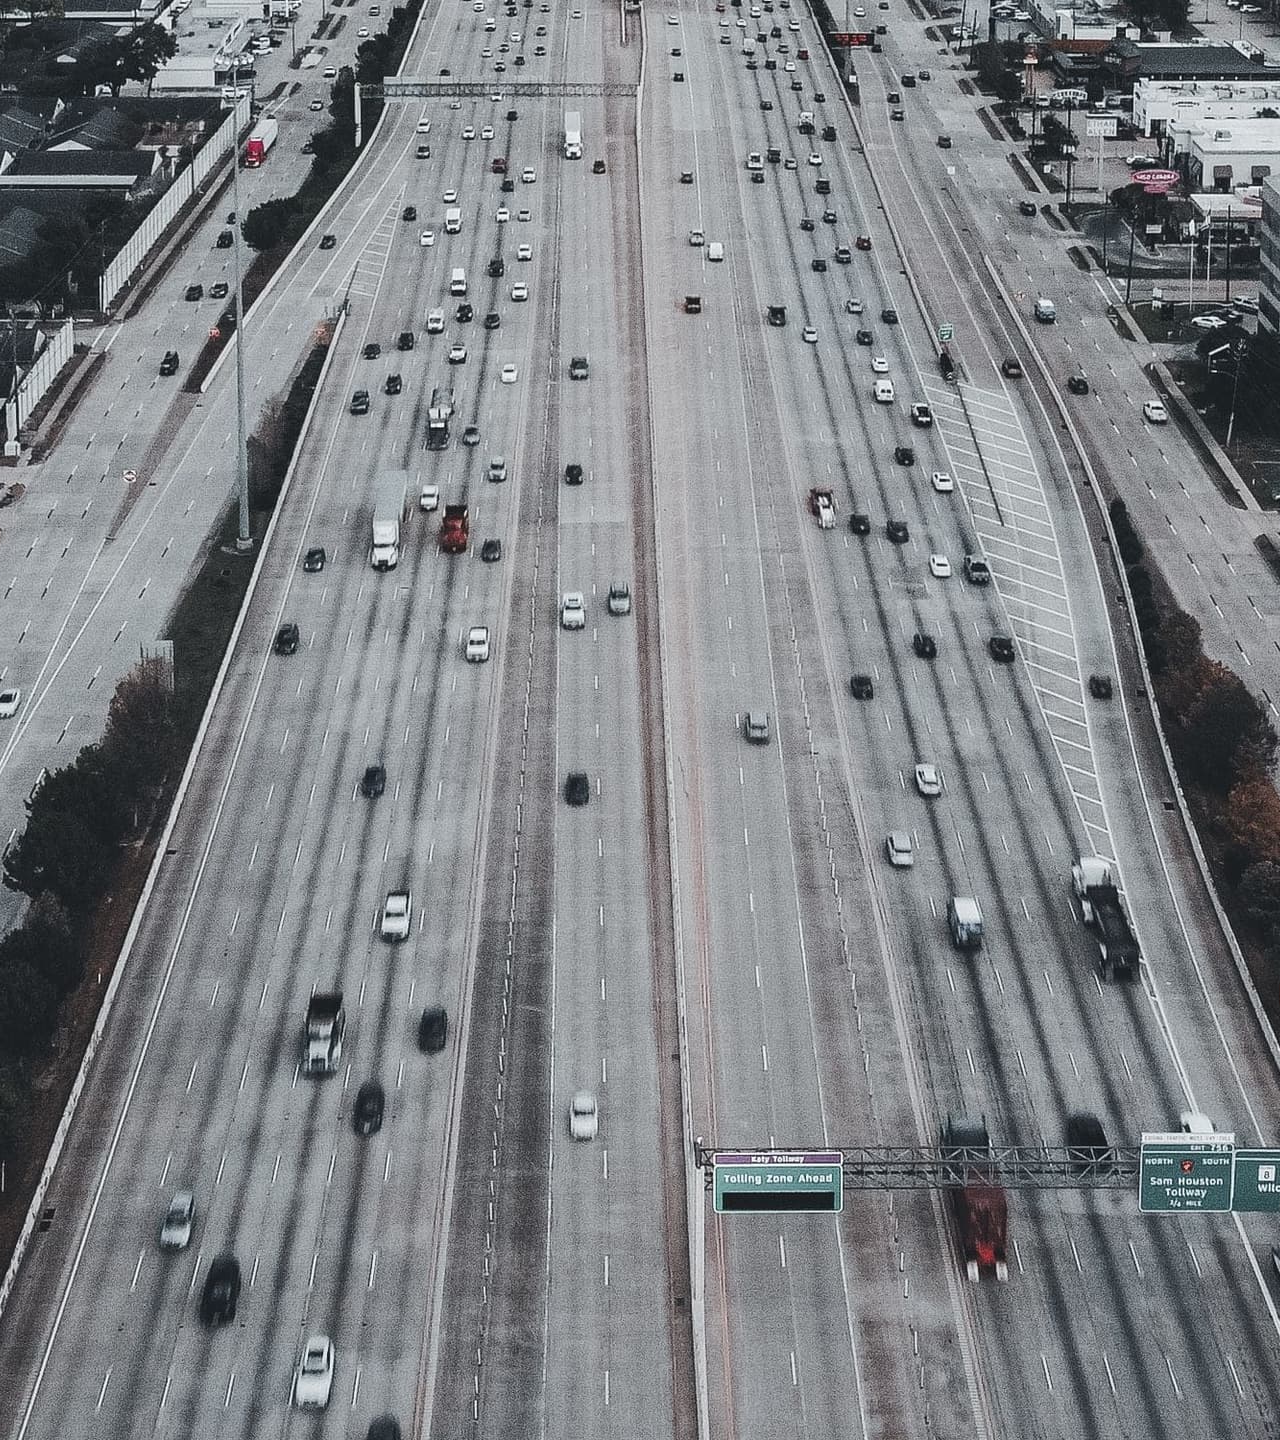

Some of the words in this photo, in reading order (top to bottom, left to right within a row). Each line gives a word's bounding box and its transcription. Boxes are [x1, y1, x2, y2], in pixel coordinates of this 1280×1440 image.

[773, 1155, 804, 1163] Tollway
[723, 1174, 761, 1184] Tolling
[766, 1174, 793, 1183] Zone
[798, 1173, 833, 1183] Ahead
[1264, 1171, 1270, 1179] 8
[1150, 1177, 1173, 1186] Sam
[1178, 1177, 1224, 1186] Houston
[1165, 1188, 1207, 1198] Tollway
